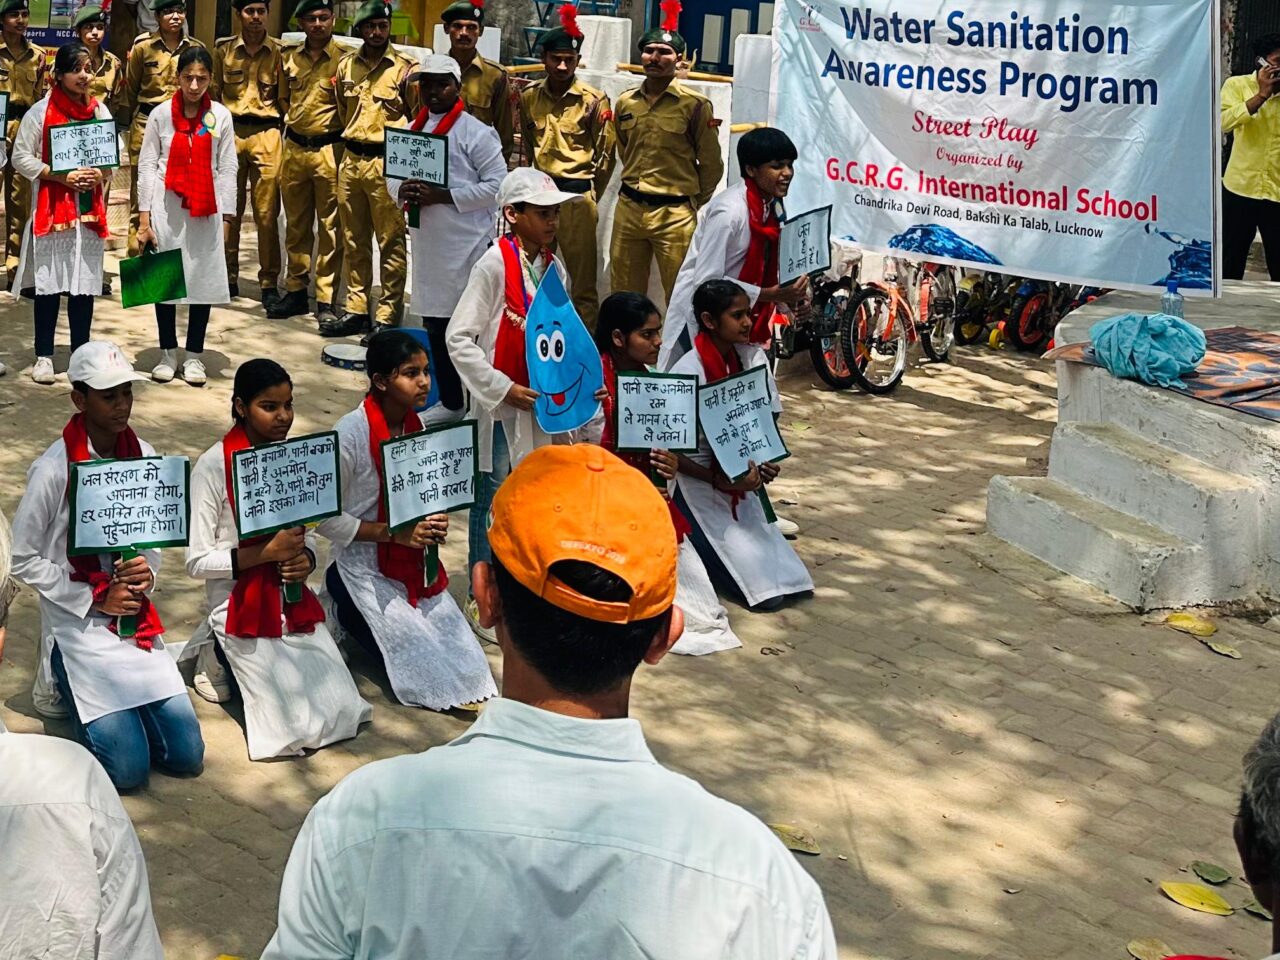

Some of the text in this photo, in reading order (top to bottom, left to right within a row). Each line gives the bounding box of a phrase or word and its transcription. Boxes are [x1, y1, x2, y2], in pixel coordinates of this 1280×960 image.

[839, 6, 1129, 55] Water Sanitation
[821, 48, 1159, 113] Awareness Program
[911, 110, 1039, 151] Street Play
[935, 147, 1024, 173] Organized by
[826, 157, 1159, 222] G.C.R.G. International School
[854, 193, 1104, 239] Chandrika Devi Road, Bakshi Ka Talab, Lucknow
[622, 378, 693, 394] पानी एक अनमोल
[704, 389, 720, 410] पानी
[747, 380, 756, 391] का
[624, 407, 633, 425] ले
[636, 413, 661, 426] मानव
[672, 413, 688, 425] कर
[725, 403, 750, 422] अनमोल
[643, 424, 653, 442] ले
[715, 428, 731, 446] पानी
[740, 422, 751, 442] तुम
[240, 451, 258, 469] पानी
[291, 442, 309, 457] पानी
[417, 451, 438, 467] अपने
[82, 462, 161, 487] जल संरक्षण को
[241, 467, 259, 487] पानी
[271, 459, 308, 479] अनमोल
[406, 471, 423, 487] लोग
[426, 469, 439, 482] कर
[440, 462, 451, 478] रहे
[107, 486, 149, 501] अपनाना
[243, 490, 252, 501] ना
[288, 476, 305, 492] पानी
[306, 471, 318, 486] को
[318, 473, 333, 490] तुम
[419, 483, 440, 504] पानी
[81, 509, 96, 523] हर
[137, 505, 155, 519] तक
[158, 503, 180, 518] जल
[245, 500, 266, 518] जानो
[269, 494, 296, 512] इसका
